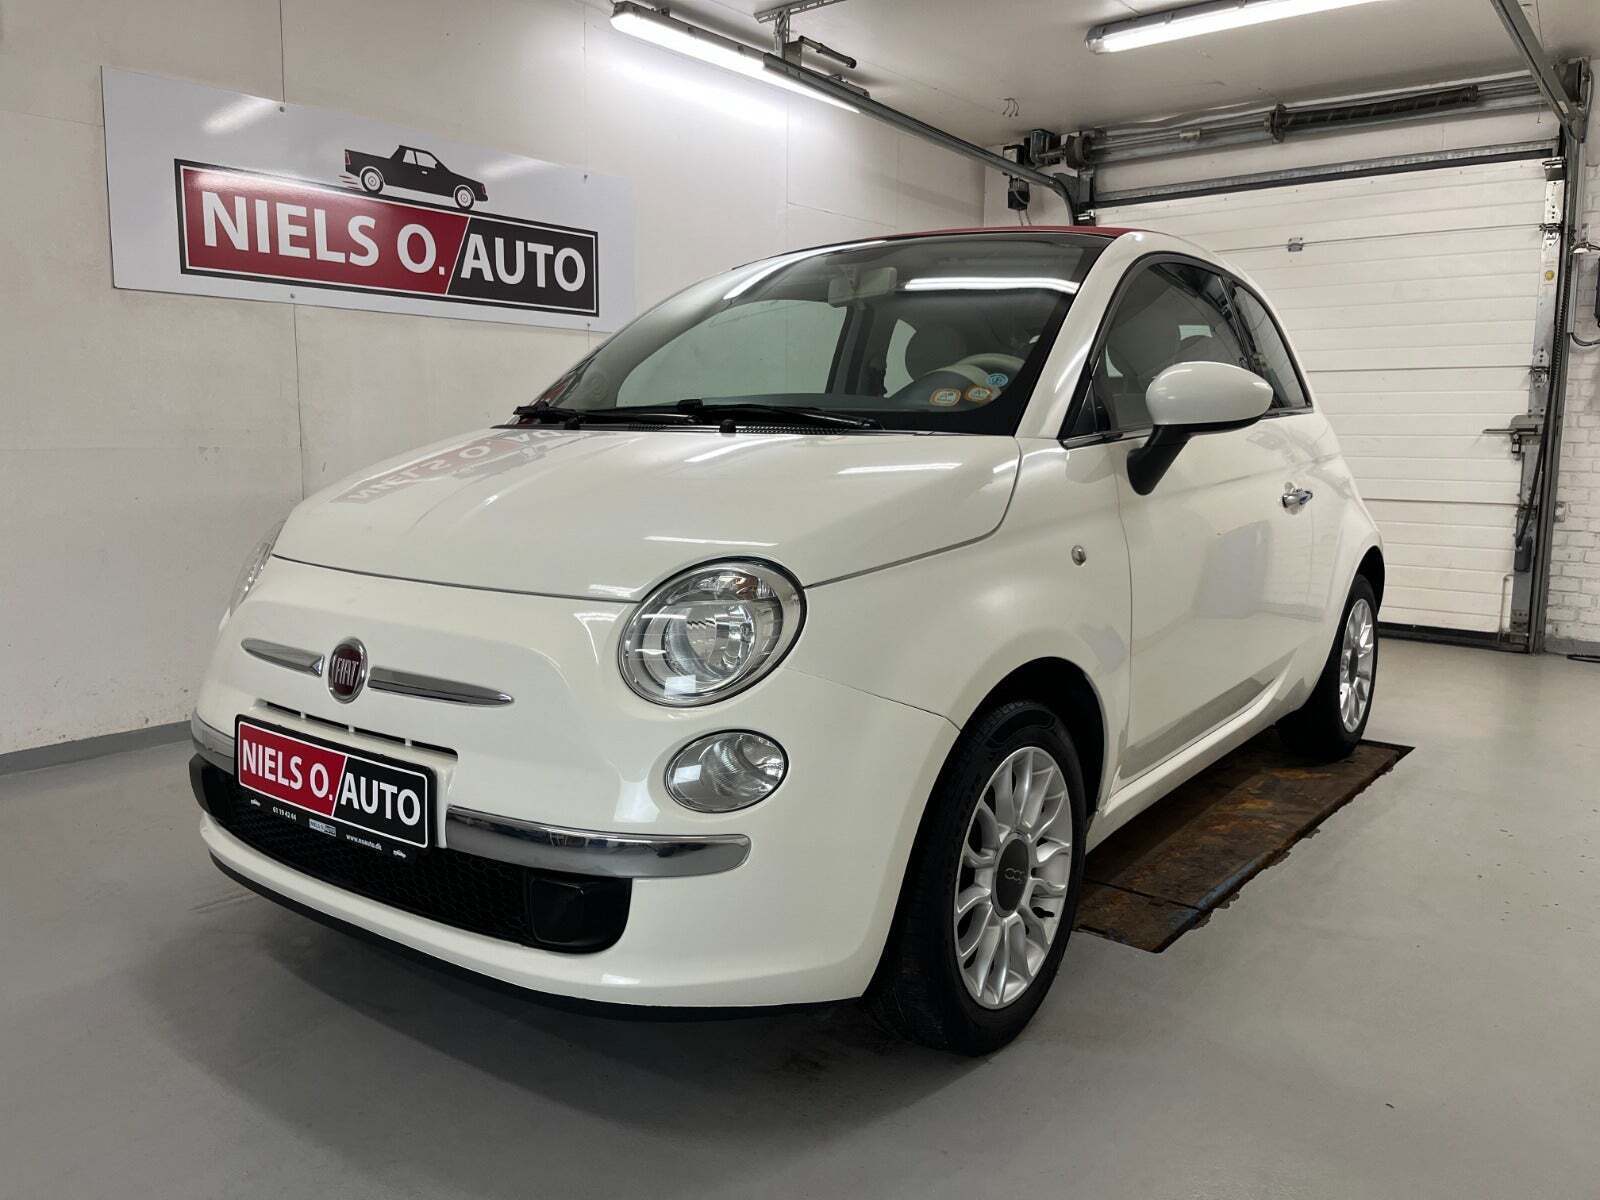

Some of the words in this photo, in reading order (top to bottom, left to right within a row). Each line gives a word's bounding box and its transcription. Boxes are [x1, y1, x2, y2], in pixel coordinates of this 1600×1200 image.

[201, 191, 380, 267] NIELS
[396, 223, 446, 276] O.
[460, 233, 587, 292] AUTO
[334, 656, 360, 687] FIAT
[242, 739, 304, 791] NIELS
[309, 762, 334, 801] O.
[339, 772, 422, 827] AUTO
